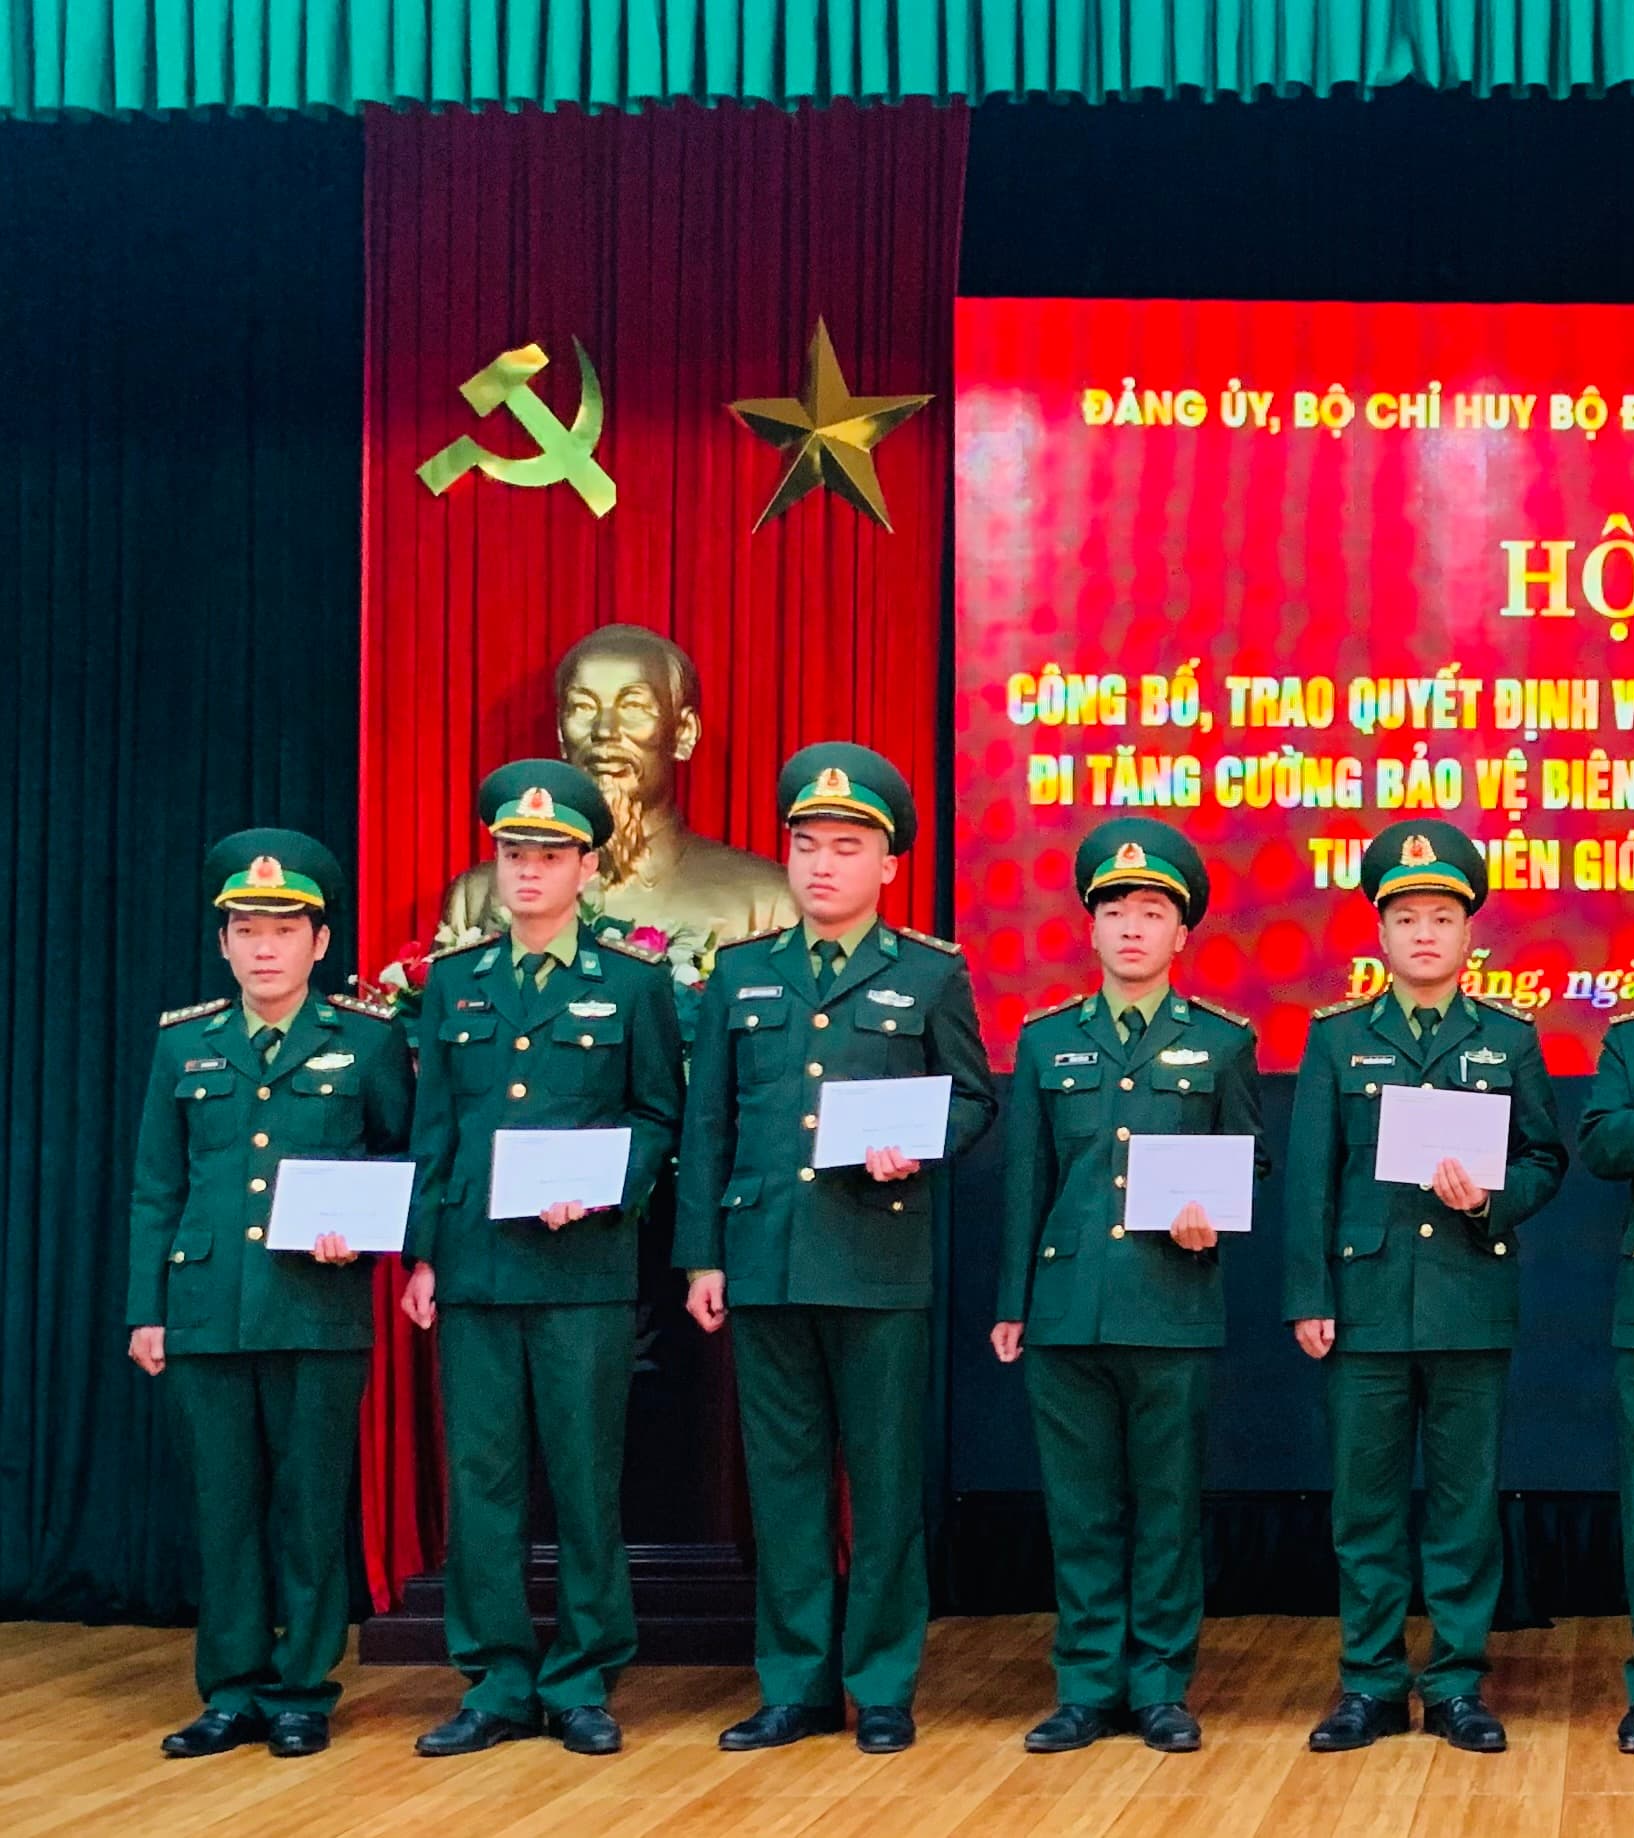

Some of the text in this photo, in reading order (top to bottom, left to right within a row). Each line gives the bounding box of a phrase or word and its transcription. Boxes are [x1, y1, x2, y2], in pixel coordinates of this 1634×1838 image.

[1082, 377, 1207, 427] ĐẢNG
[1220, 378, 1280, 434] ỦY,
[1294, 384, 1352, 438] BỘ
[1366, 381, 1441, 429] CHỈ
[1455, 392, 1536, 430] HUY
[1550, 386, 1607, 440] BỘ
[1007, 662, 1127, 727] CÔNG
[1140, 657, 1213, 733] BỐ,
[1225, 676, 1334, 728] TRAO
[1348, 662, 1482, 735] QUYẾT
[1494, 678, 1599, 742] ĐỊNH
[1027, 755, 1074, 806] ĐI
[1086, 745, 1201, 808] TĂNG
[1215, 744, 1362, 810] CƯỜNG
[1376, 742, 1462, 810] BẢO
[1476, 748, 1527, 821] VỆ
[1345, 957, 1393, 999] Đ
[1460, 948, 1551, 1008] ẵng,
